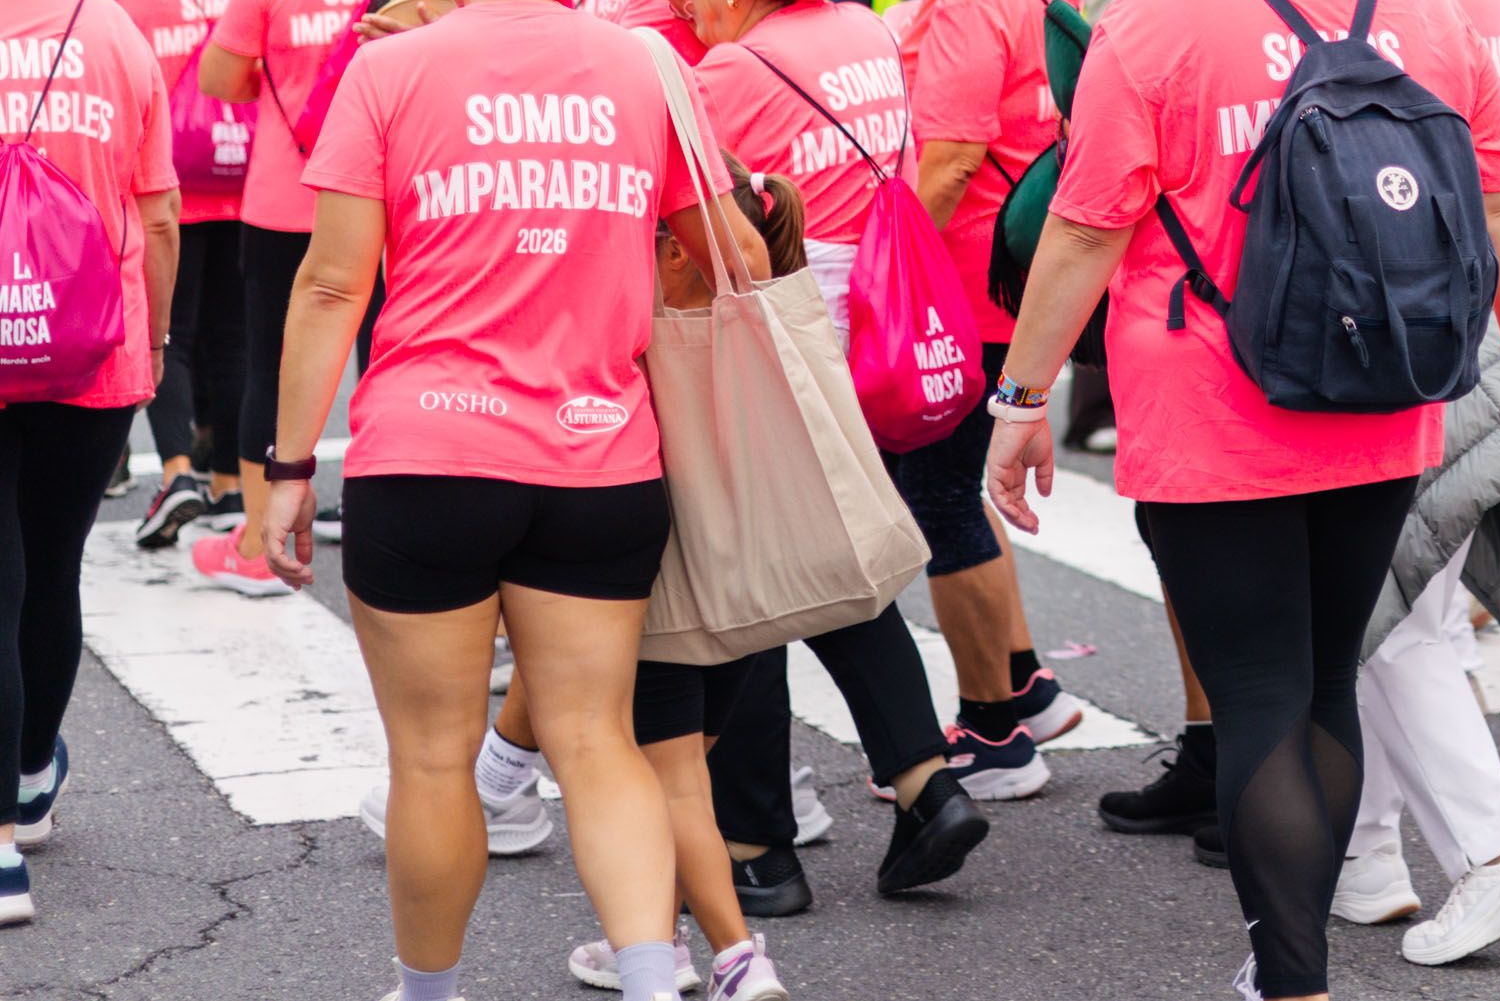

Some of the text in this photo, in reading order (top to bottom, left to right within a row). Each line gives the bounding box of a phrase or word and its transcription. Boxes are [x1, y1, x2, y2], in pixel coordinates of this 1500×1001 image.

[466, 93, 616, 146] SOMOS
[411, 158, 654, 222] IMPARABLES
[516, 227, 568, 255] 2026
[419, 391, 508, 417] OYSHO
[920, 368, 964, 404] ROSA
